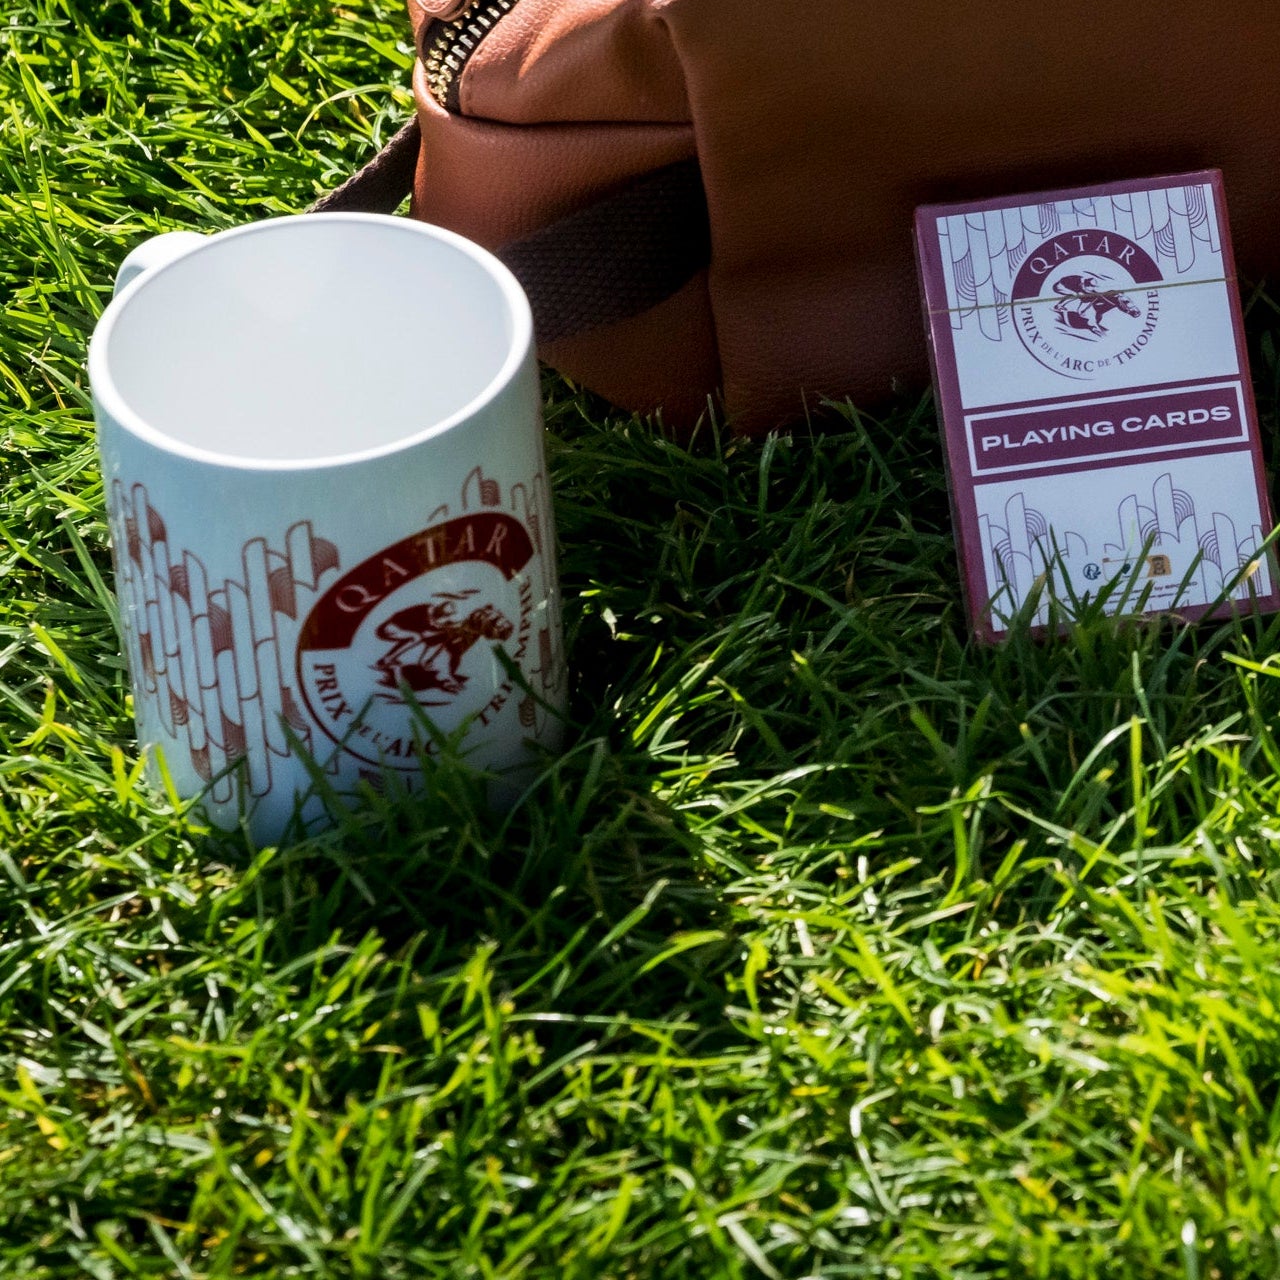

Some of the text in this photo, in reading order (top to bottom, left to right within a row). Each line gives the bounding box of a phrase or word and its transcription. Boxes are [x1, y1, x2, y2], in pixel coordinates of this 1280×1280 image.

[1029, 232, 1137, 276] QATAR
[1020, 288, 1161, 373] PRIX DE L'ARC DE TRIOMPHE
[980, 405, 1233, 453] PLAYING CARDS
[335, 522, 508, 613] QATAR
[312, 663, 354, 722] PRIX
[478, 575, 532, 726] TRIMPHE
